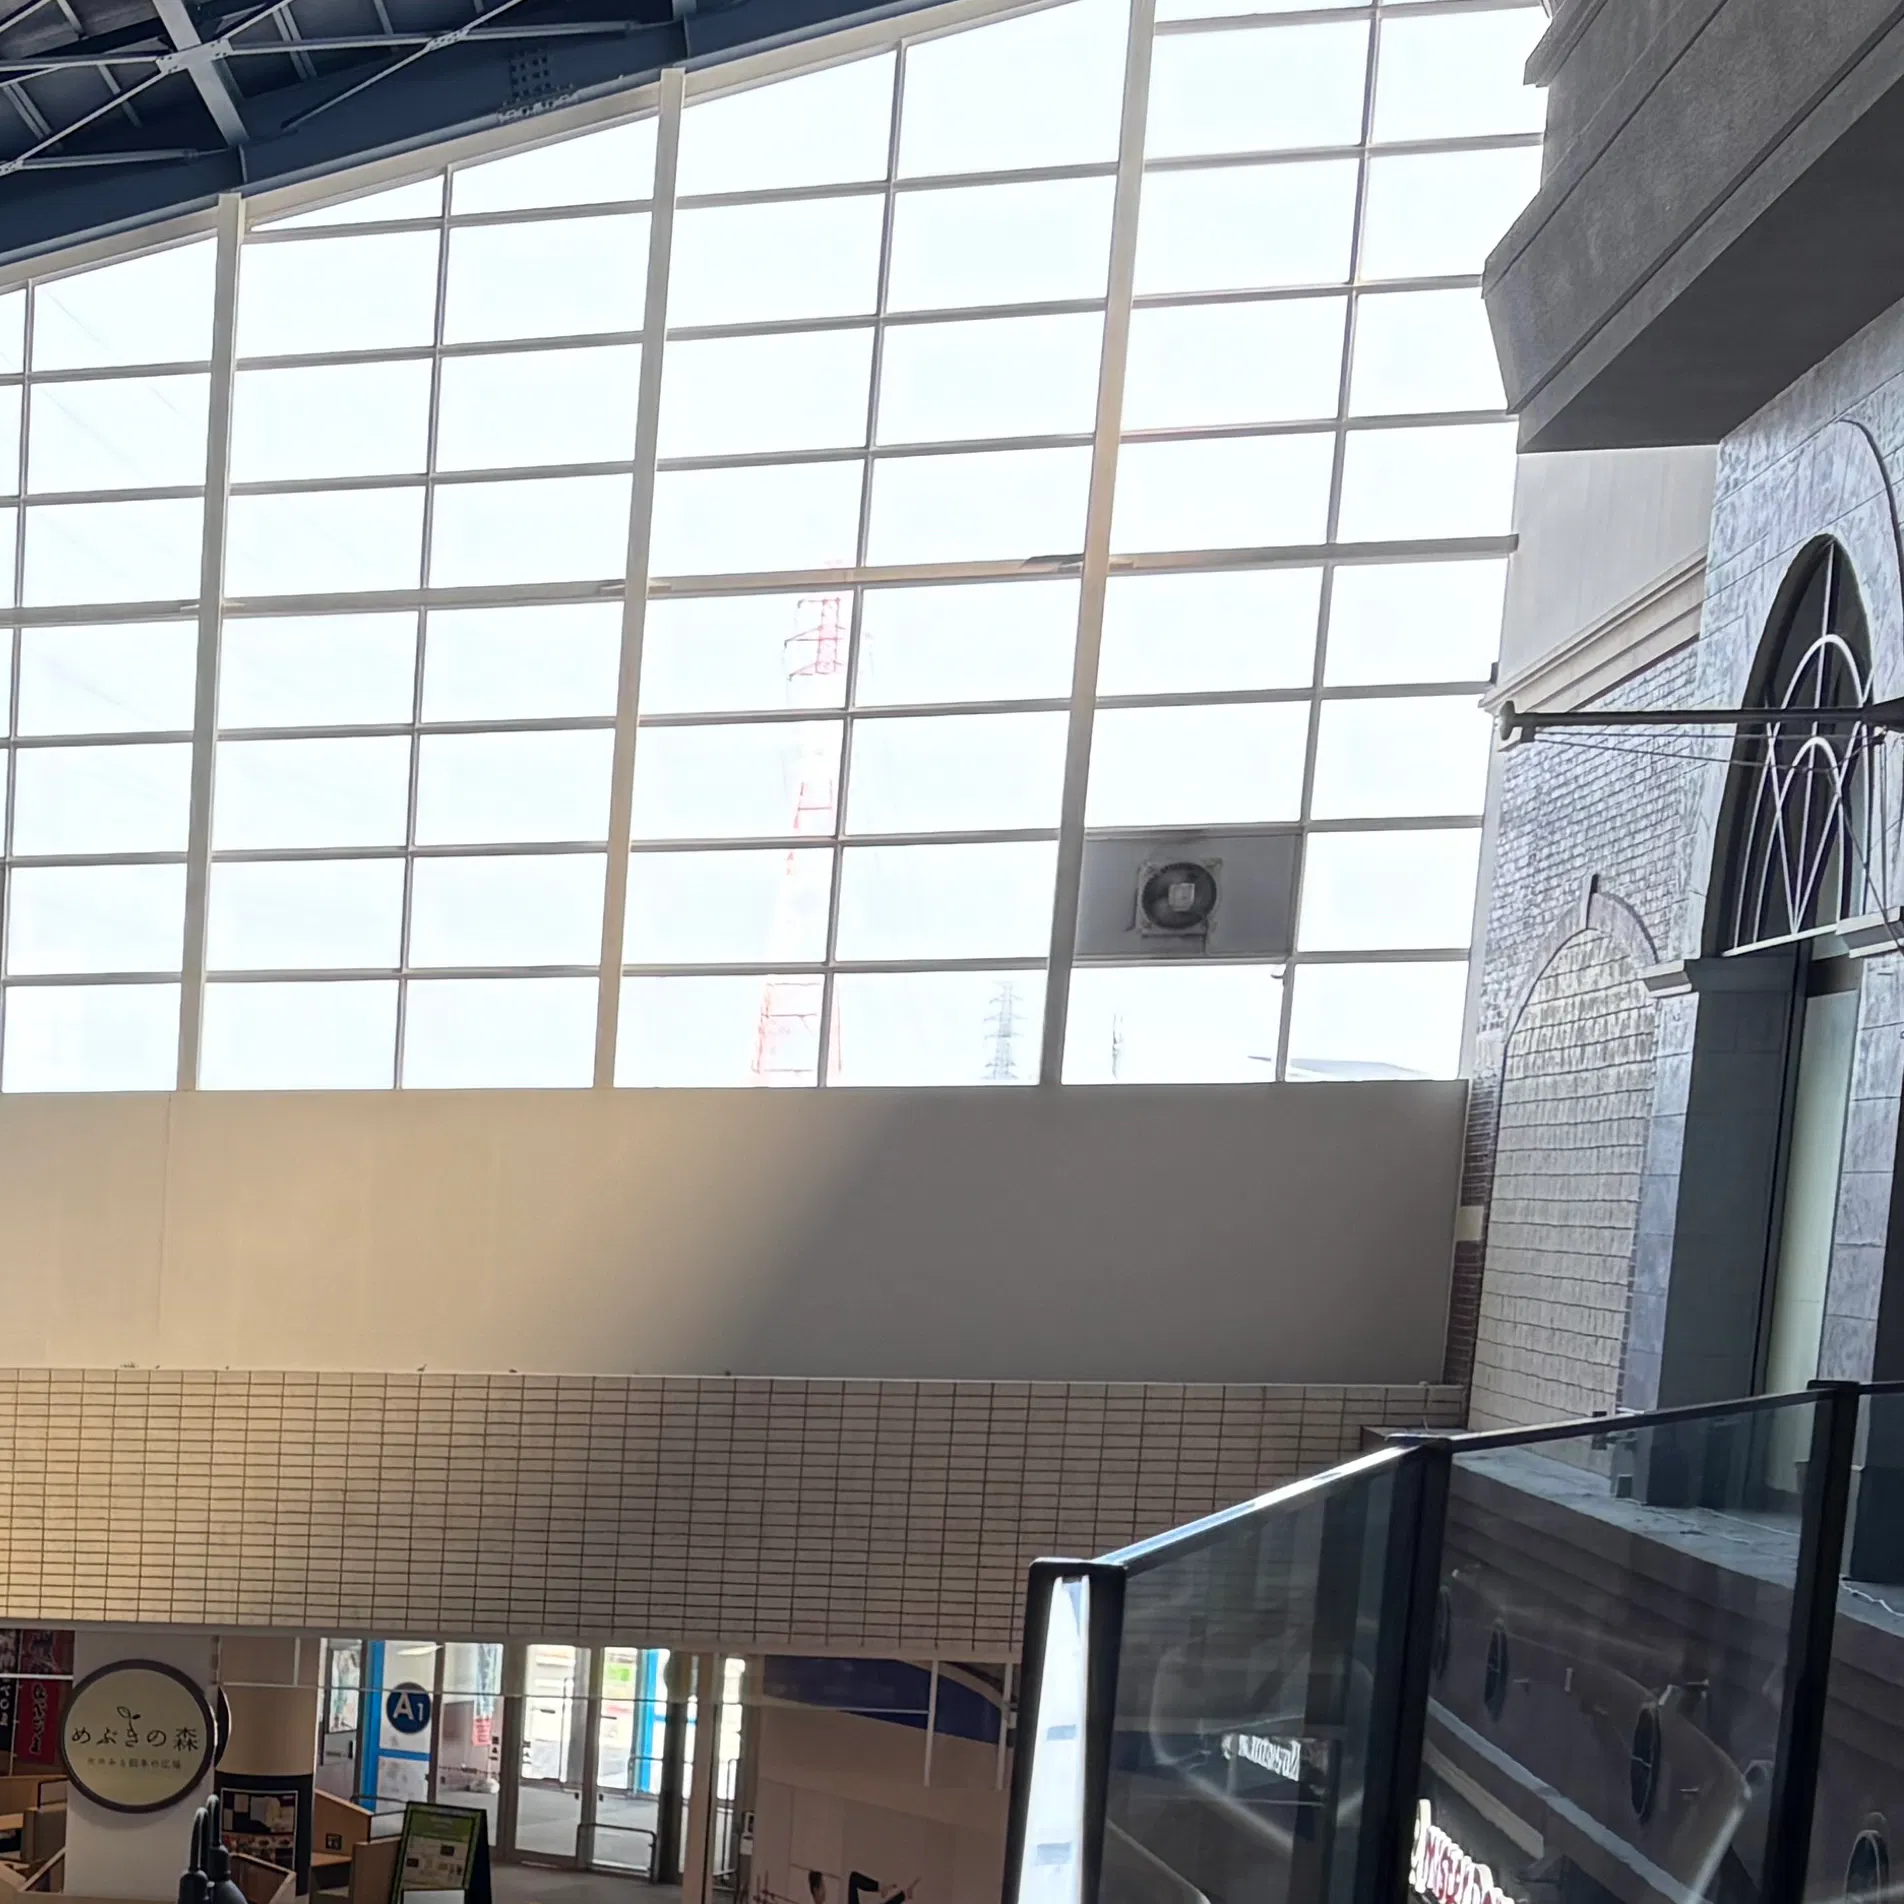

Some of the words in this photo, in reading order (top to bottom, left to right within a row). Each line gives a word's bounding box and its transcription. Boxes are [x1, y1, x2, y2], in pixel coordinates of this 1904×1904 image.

[71, 1724, 200, 1752] めぶきの森
